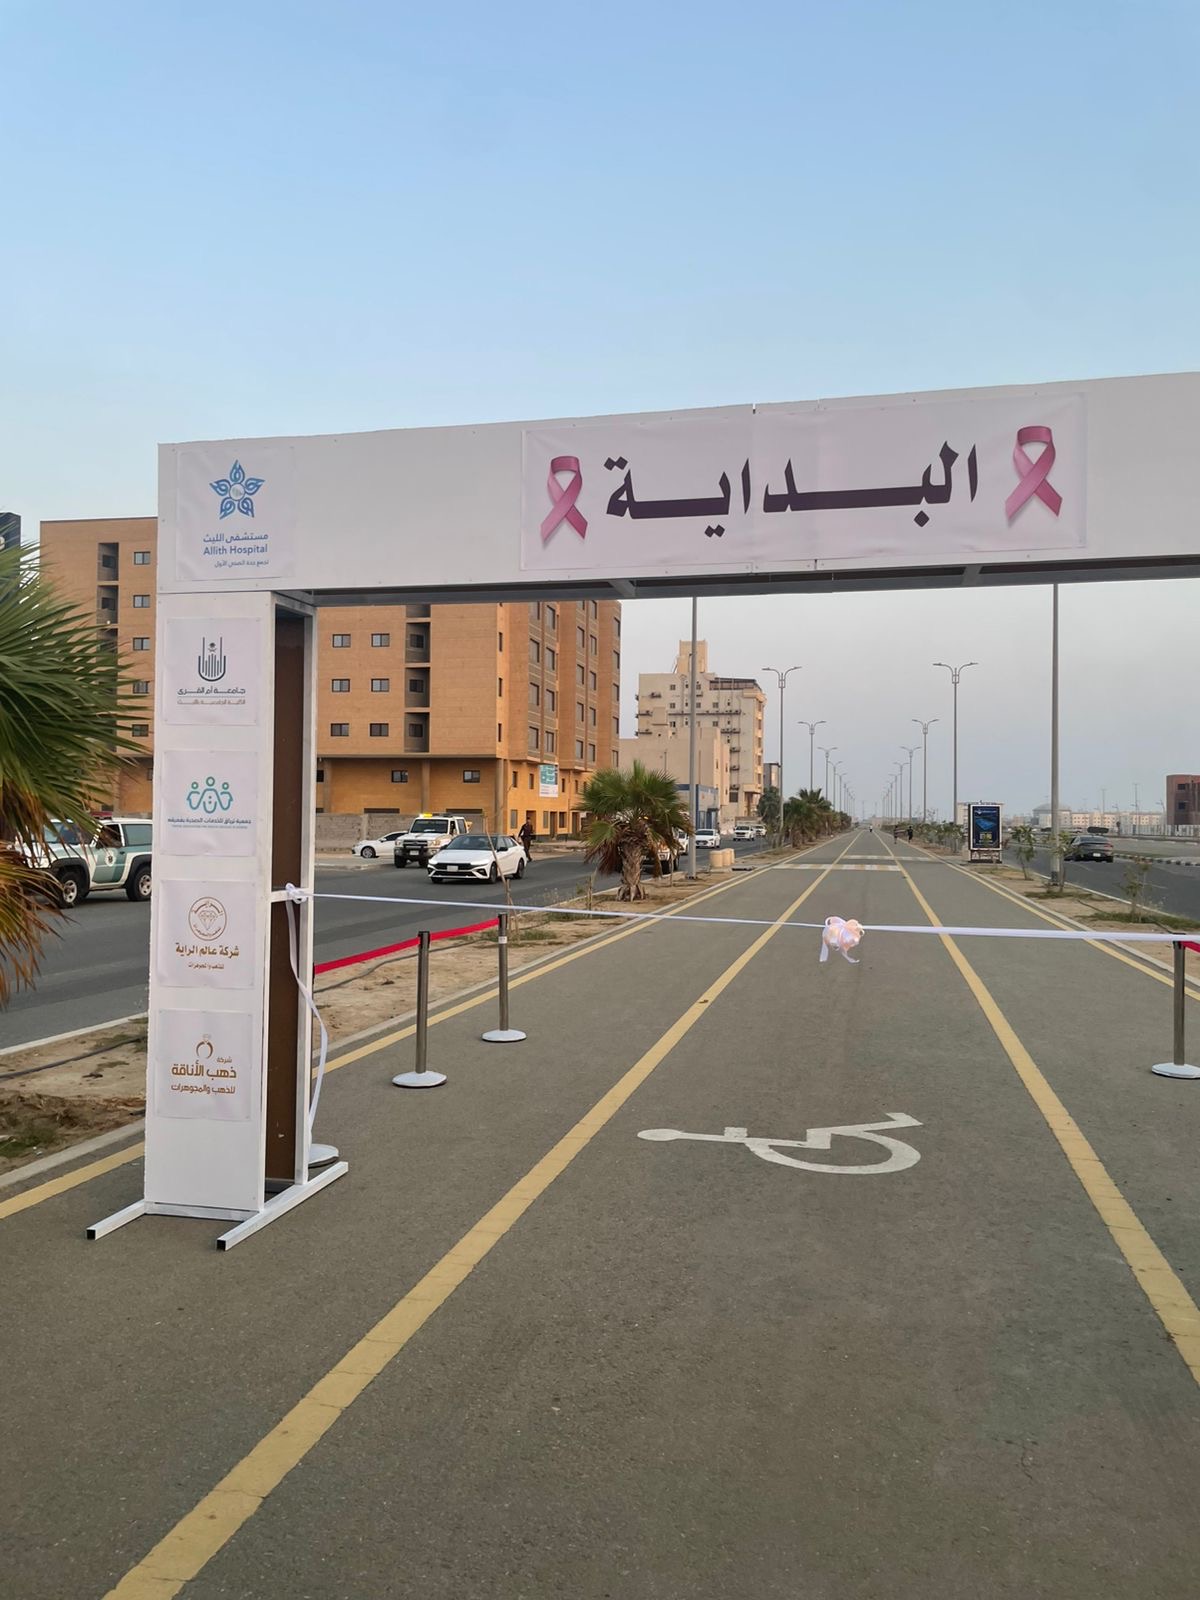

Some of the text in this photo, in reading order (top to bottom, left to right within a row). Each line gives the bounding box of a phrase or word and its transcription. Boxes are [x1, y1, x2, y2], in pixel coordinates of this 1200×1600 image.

[603, 440, 978, 538] البداية
[202, 531, 269, 545] مستشفى الليث
[203, 543, 268, 556] Allith Hospital
[177, 686, 205, 696] القرى
[213, 685, 246, 695] جامعة
[175, 942, 240, 959] شركة عالم الراية
[171, 1060, 237, 1081] ذهب الأناقة
[211, 1084, 236, 1095] للذهب
